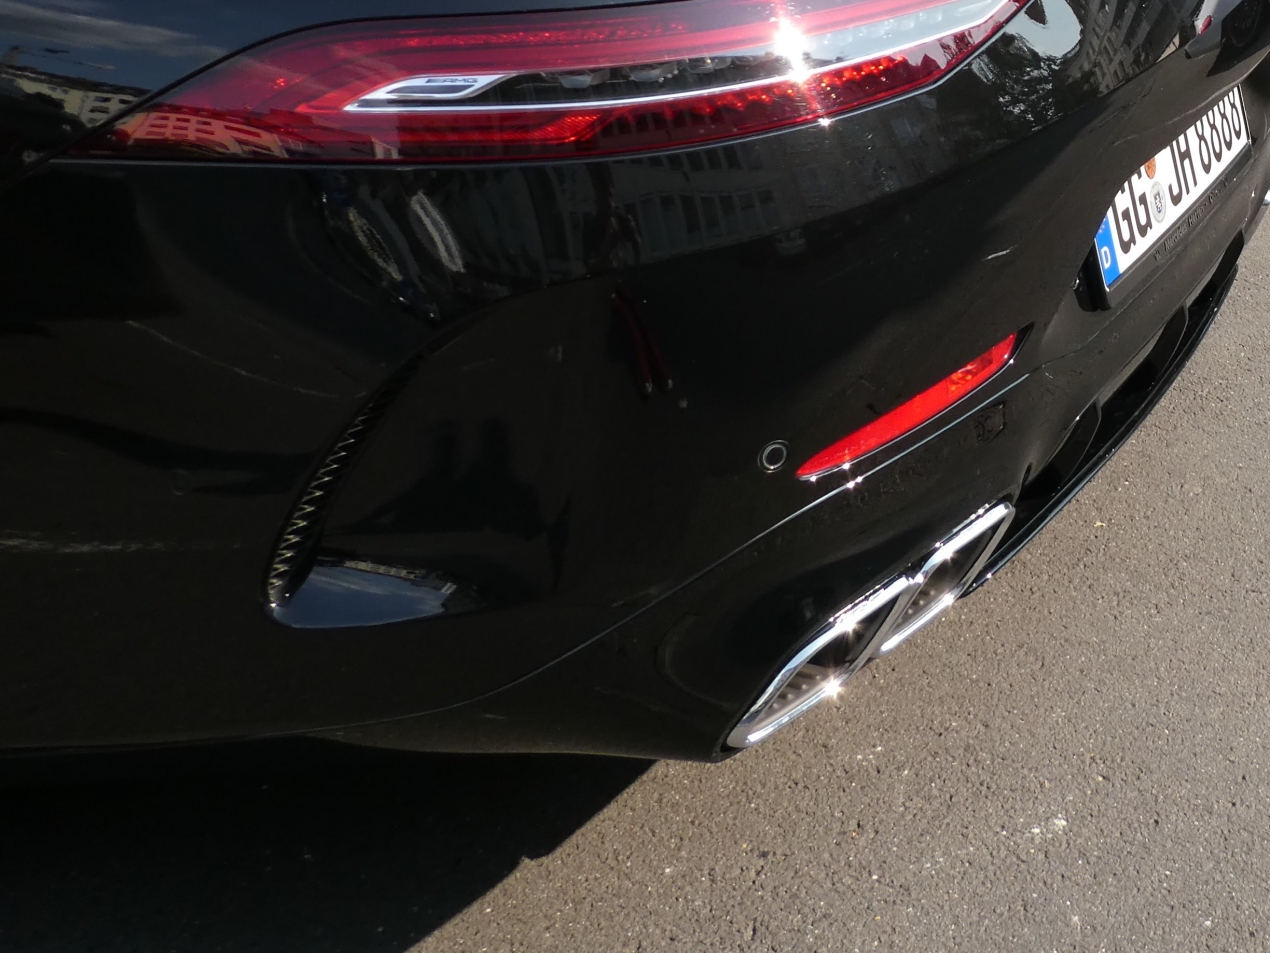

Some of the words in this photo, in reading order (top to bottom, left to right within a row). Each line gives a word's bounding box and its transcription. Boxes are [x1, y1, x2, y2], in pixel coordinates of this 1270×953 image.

[1111, 167, 1153, 255] GG
[1167, 132, 1198, 207] JH
[1194, 90, 1242, 175] 8888
[1099, 245, 1112, 270] D
